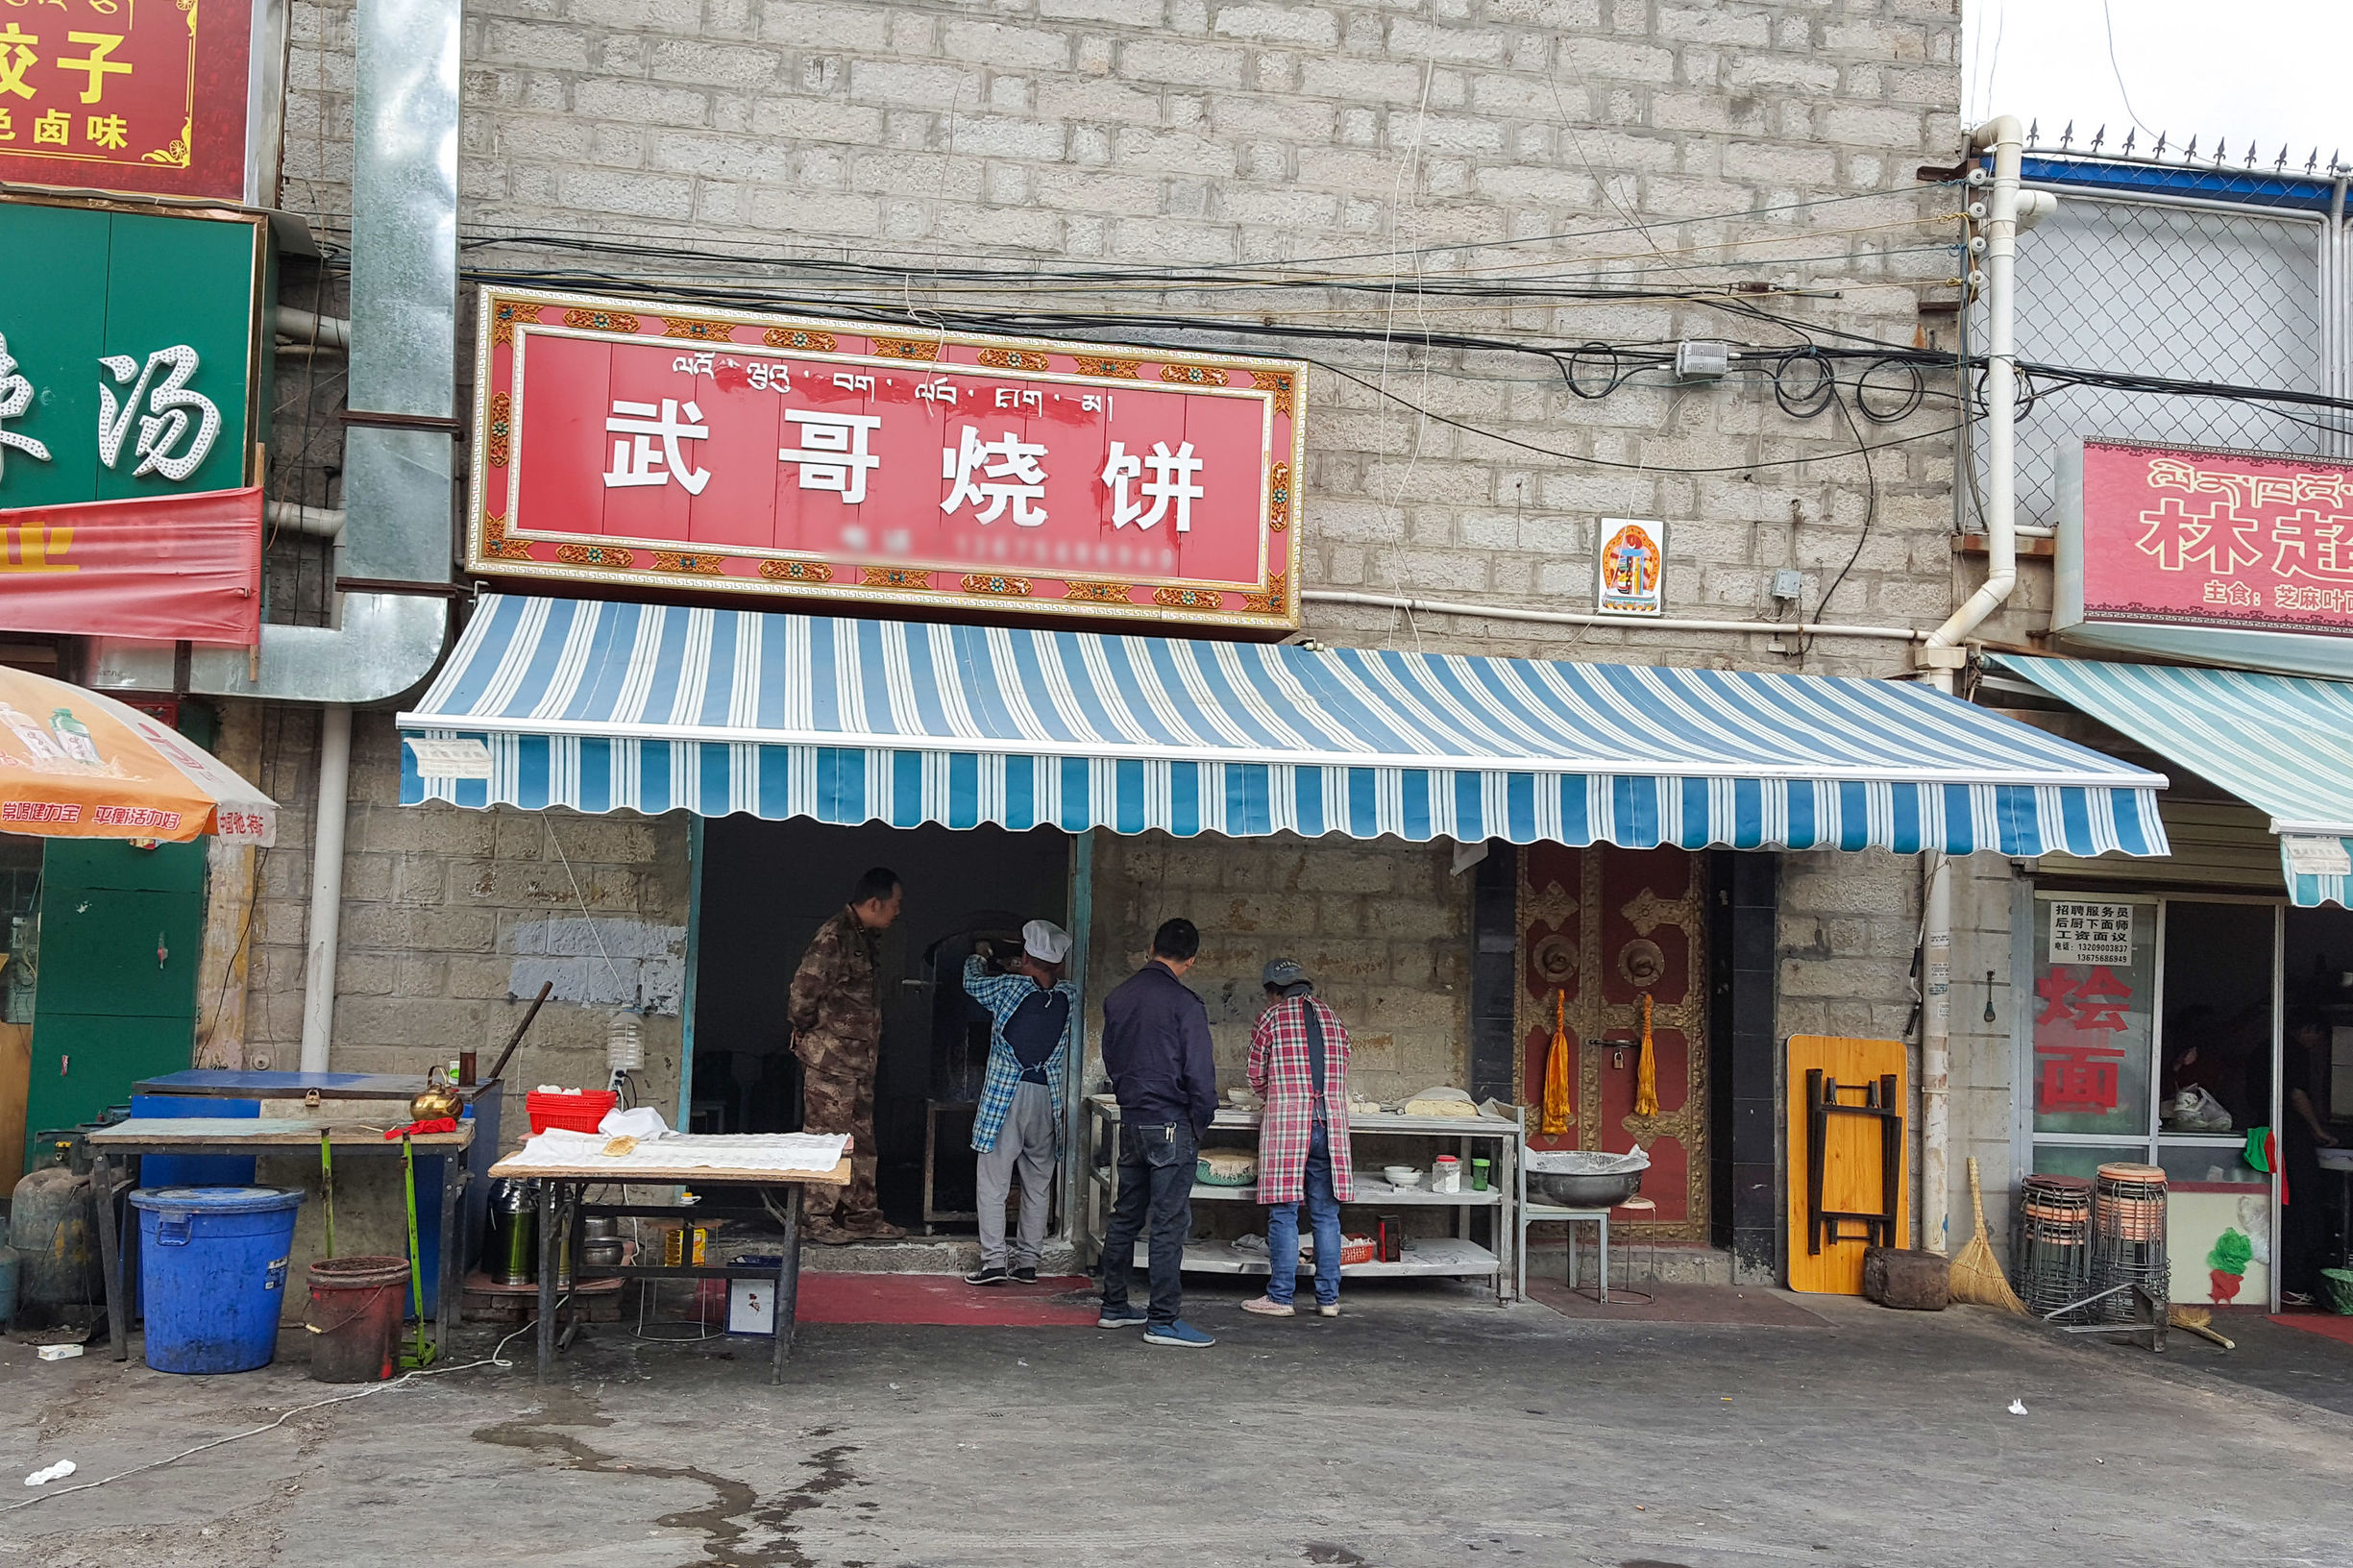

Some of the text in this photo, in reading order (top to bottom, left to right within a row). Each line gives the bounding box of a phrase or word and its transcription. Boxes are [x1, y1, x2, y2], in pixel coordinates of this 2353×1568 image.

[602, 398, 1205, 533] 武哥烧饼
[2055, 905, 2129, 919] 招聘服务员
[2055, 918, 2129, 931] 后厨下面师
[2055, 930, 2127, 943] 工资面议
[2036, 966, 2133, 1109] 烩面
